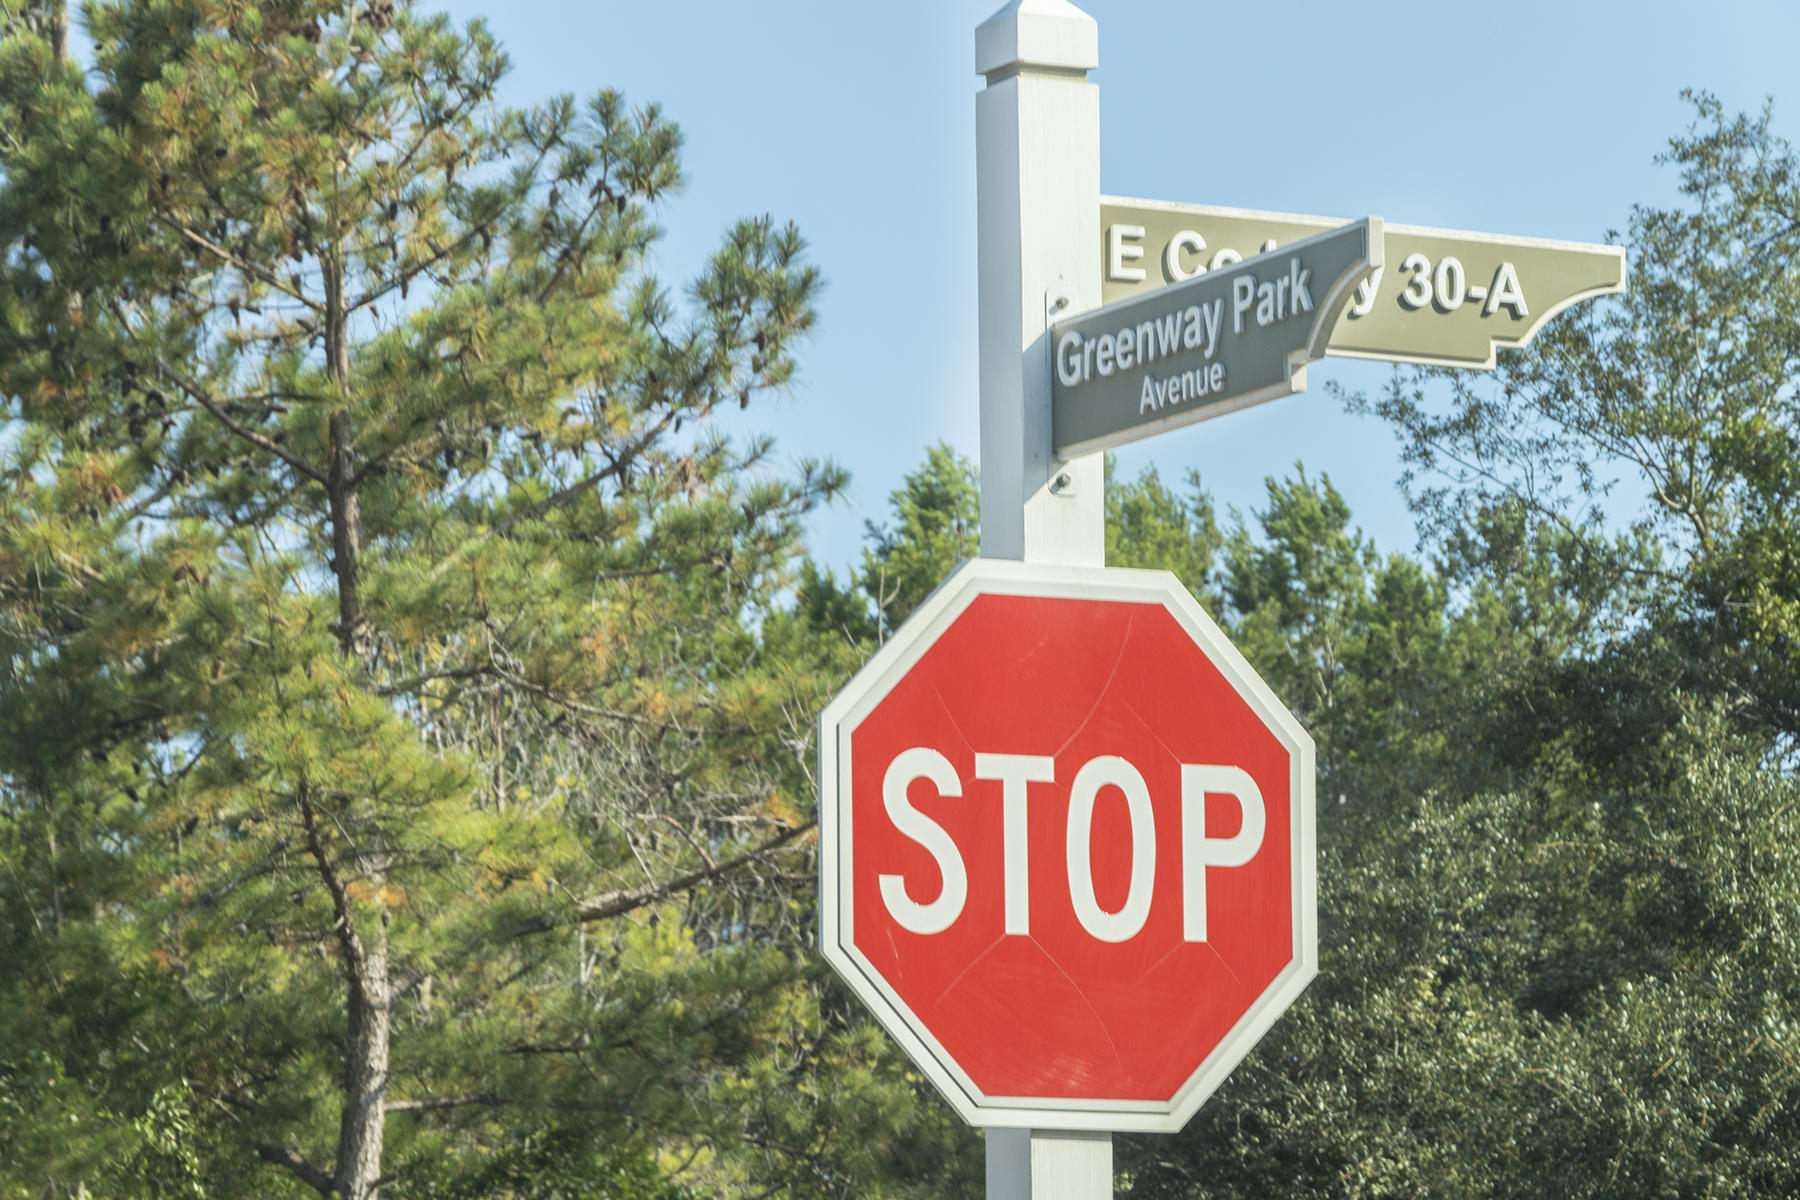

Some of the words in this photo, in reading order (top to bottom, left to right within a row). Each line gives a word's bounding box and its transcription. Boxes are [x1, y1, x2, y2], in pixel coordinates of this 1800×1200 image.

[1057, 298, 1226, 388] Greenway
[1233, 257, 1315, 335] Park
[1110, 223, 1147, 281] E
[1403, 253, 1529, 317] 30-A
[1139, 362, 1227, 416] Avenue
[878, 747, 1267, 943] STOP
